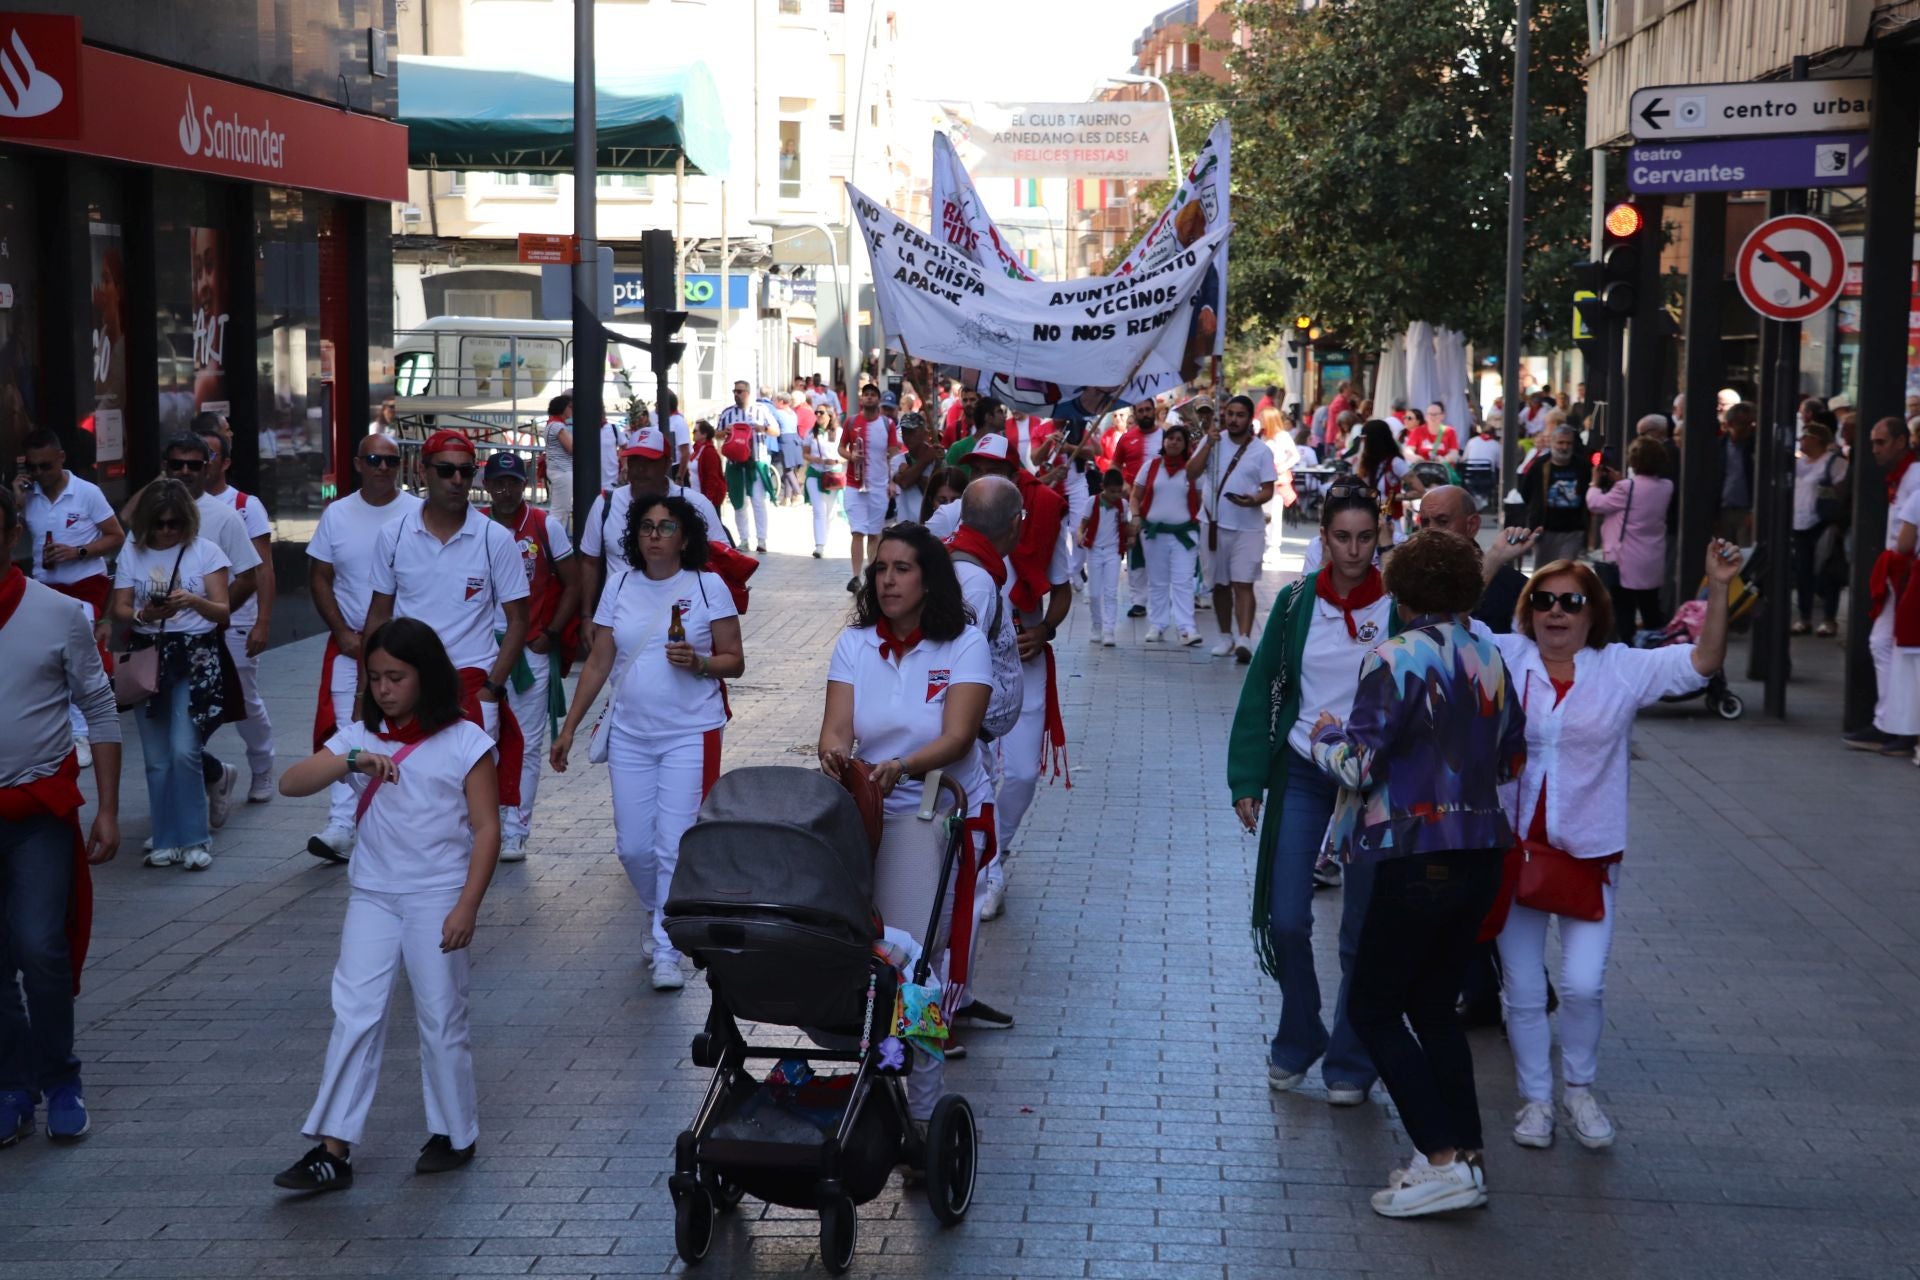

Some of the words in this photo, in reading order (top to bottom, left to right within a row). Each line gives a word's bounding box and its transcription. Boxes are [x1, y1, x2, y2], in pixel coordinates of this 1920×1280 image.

[1723, 100, 1797, 119] centro
[1012, 114, 1025, 126] EL
[1030, 114, 1065, 126] CLUB
[1070, 113, 1132, 126] TAURINO
[203, 105, 286, 169] Santander
[993, 132, 1075, 144] ARNEDANO
[1079, 132, 1101, 144] LES
[1105, 131, 1150, 144] DESEA
[1013, 149, 1070, 162] ¡FELICES
[1073, 149, 1129, 162] FIESTAS!
[1633, 148, 1682, 161] teatro
[1633, 164, 1745, 184] Cervantes
[857, 197, 881, 222] NO
[898, 246, 916, 266] LA
[613, 280, 645, 304] pti
[1033, 324, 1062, 341] NO
[1071, 323, 1116, 341] NOS
